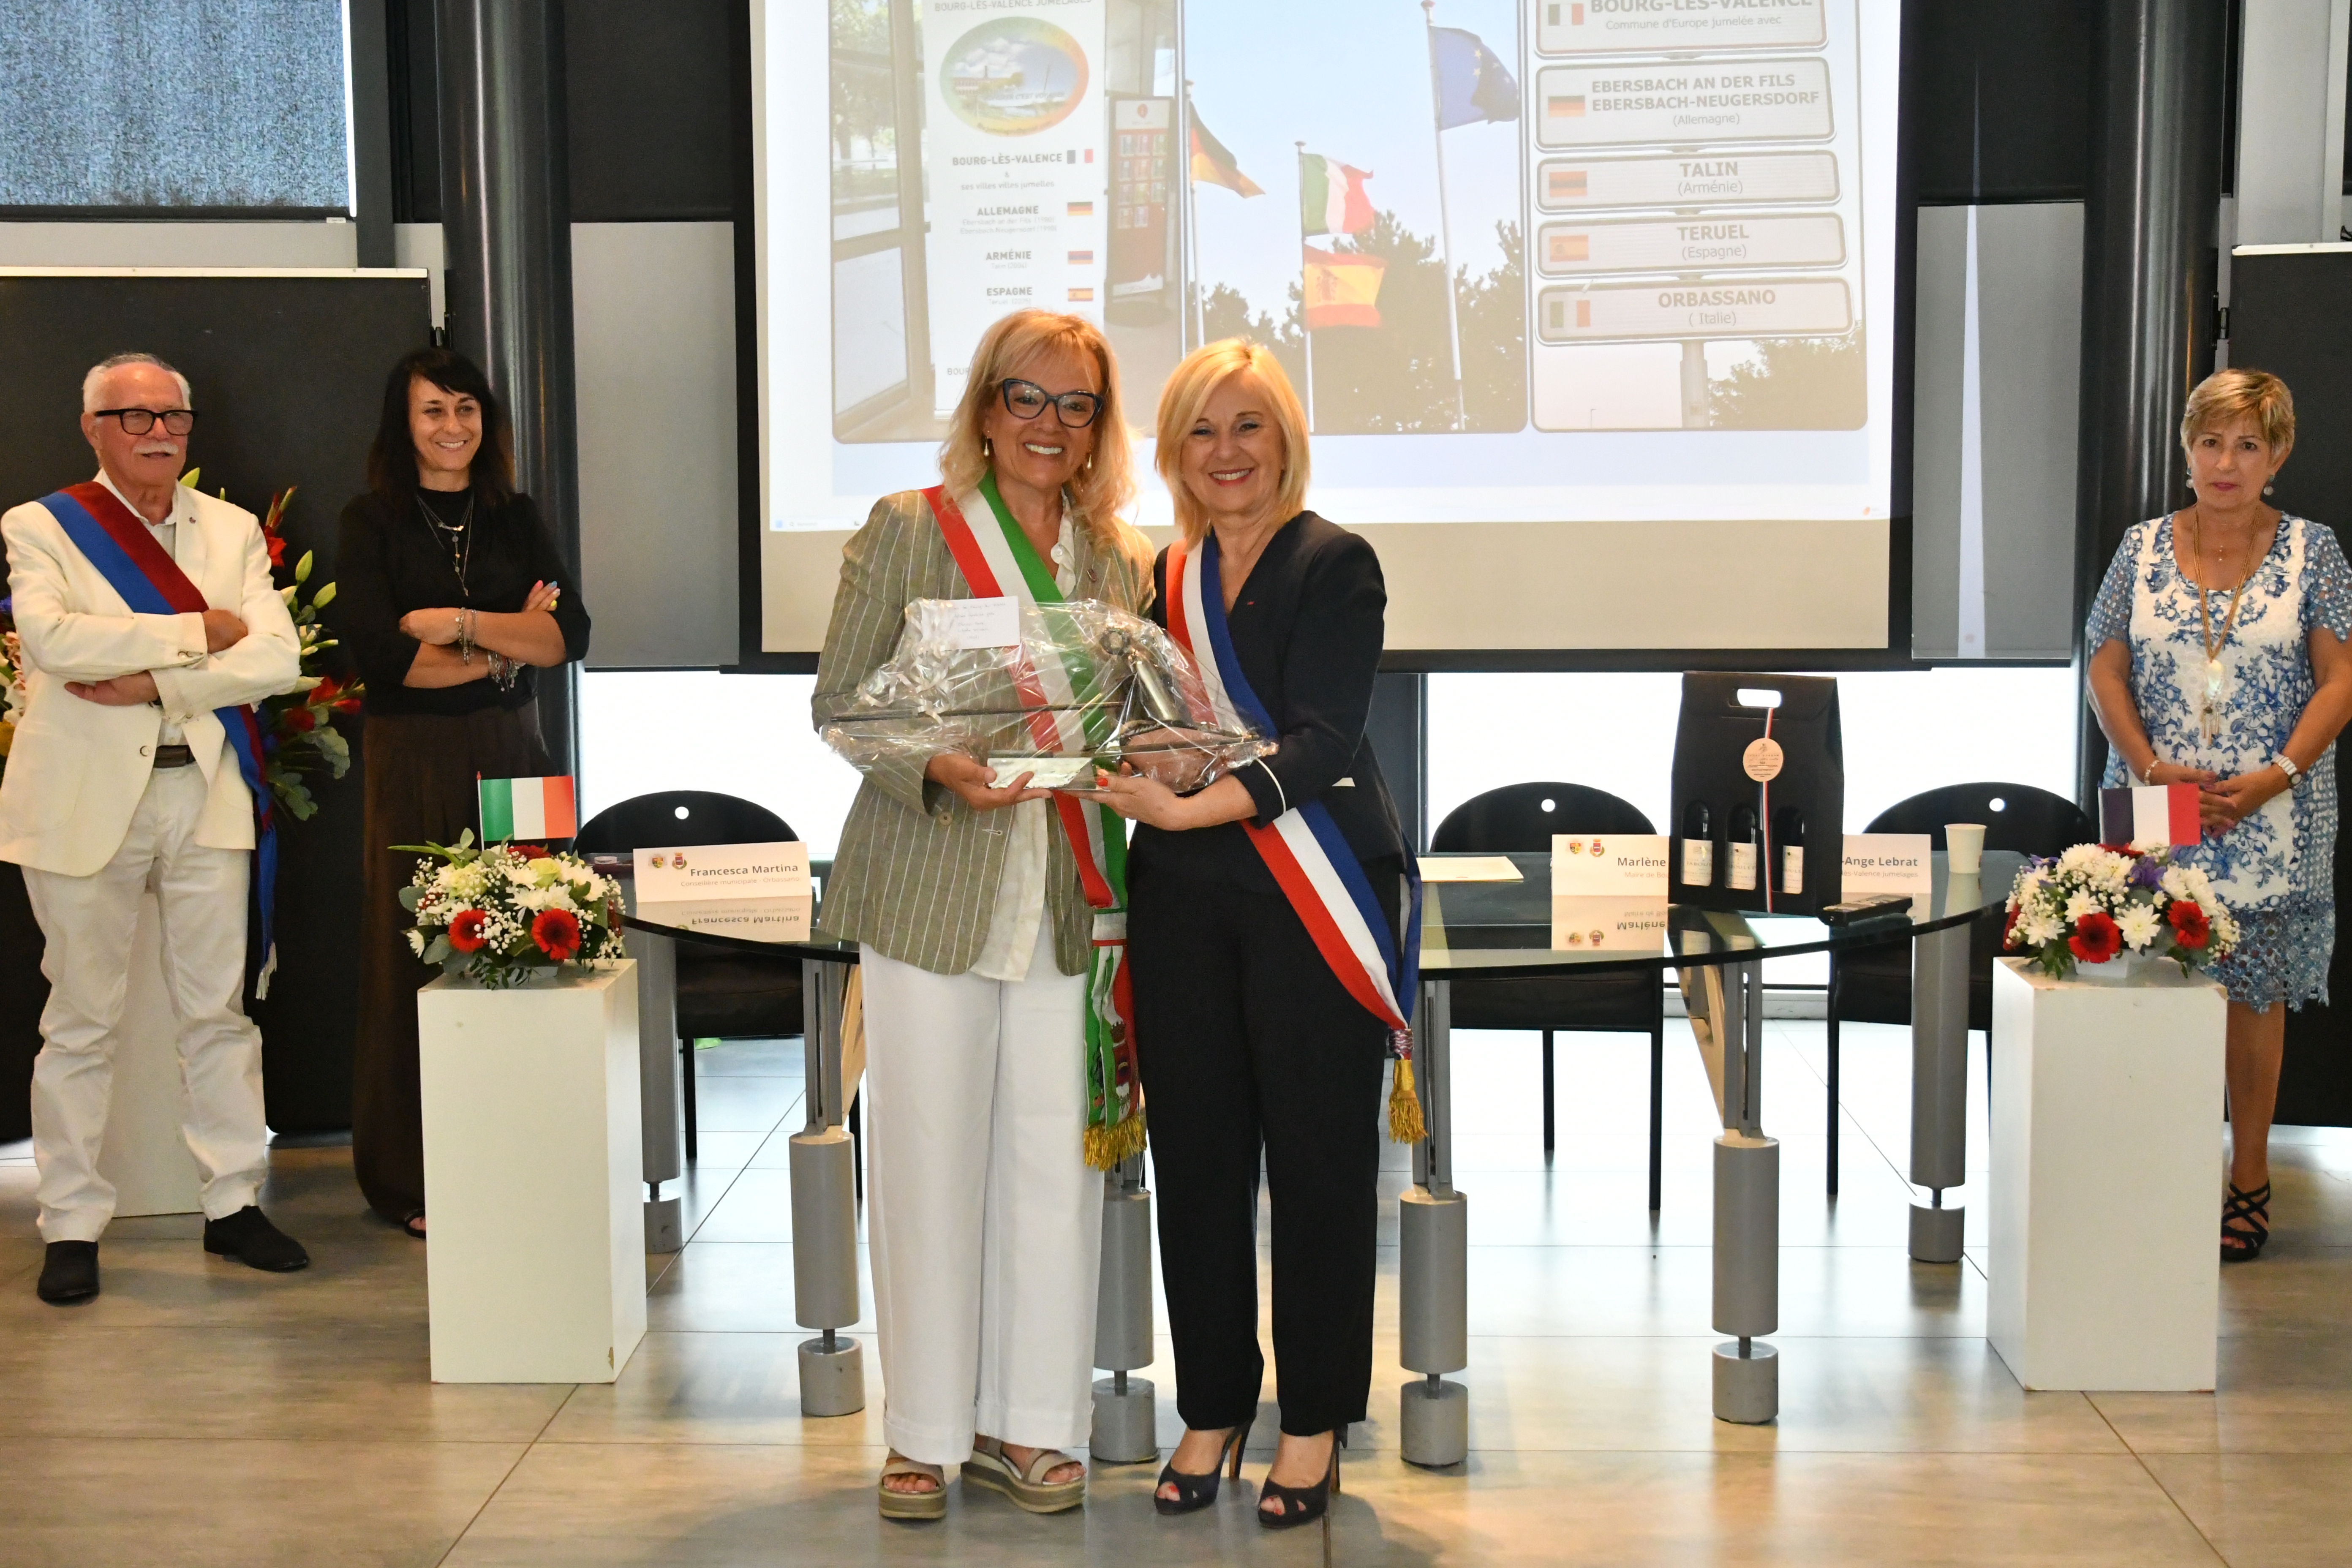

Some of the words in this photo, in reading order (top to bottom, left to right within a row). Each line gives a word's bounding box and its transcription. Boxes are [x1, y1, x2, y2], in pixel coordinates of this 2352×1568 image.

[1606, 19, 1659, 30] Commune
[1663, 18, 1708, 29] d'Europe
[1711, 15, 1753, 28] jumelée
[1757, 16, 1782, 25] avec
[1591, 78, 1688, 93] EBERSBACH
[1693, 77, 1716, 90] AN
[1722, 76, 1753, 89] DER
[1759, 74, 1795, 87] FILS
[1592, 91, 1819, 112] EBERSBACH-NEUGERSDORF
[1672, 113, 1740, 127] (Allemagne)
[953, 153, 1063, 166] BOURG-LÈS-VALENCE
[1680, 161, 1739, 178] TALIN
[1021, 180, 1055, 189] jumelles
[1678, 179, 1743, 196] (Arménie)
[977, 206, 1039, 216] ALLEMAGNE
[1677, 224, 1750, 241] TERUEL
[986, 248, 1032, 261] ARMÉNIE
[1682, 244, 1748, 260] (Espagne)
[986, 287, 1033, 297] ESPAGNE
[1658, 289, 1776, 308] ORBASSANO
[1617, 857, 1666, 867] Marlène
[1878, 857, 1918, 866] Lebrat
[690, 866, 749, 877] Francesca
[752, 863, 799, 874] Martina
[1882, 871, 1918, 879] jumelages
[720, 878, 757, 886] municipale
